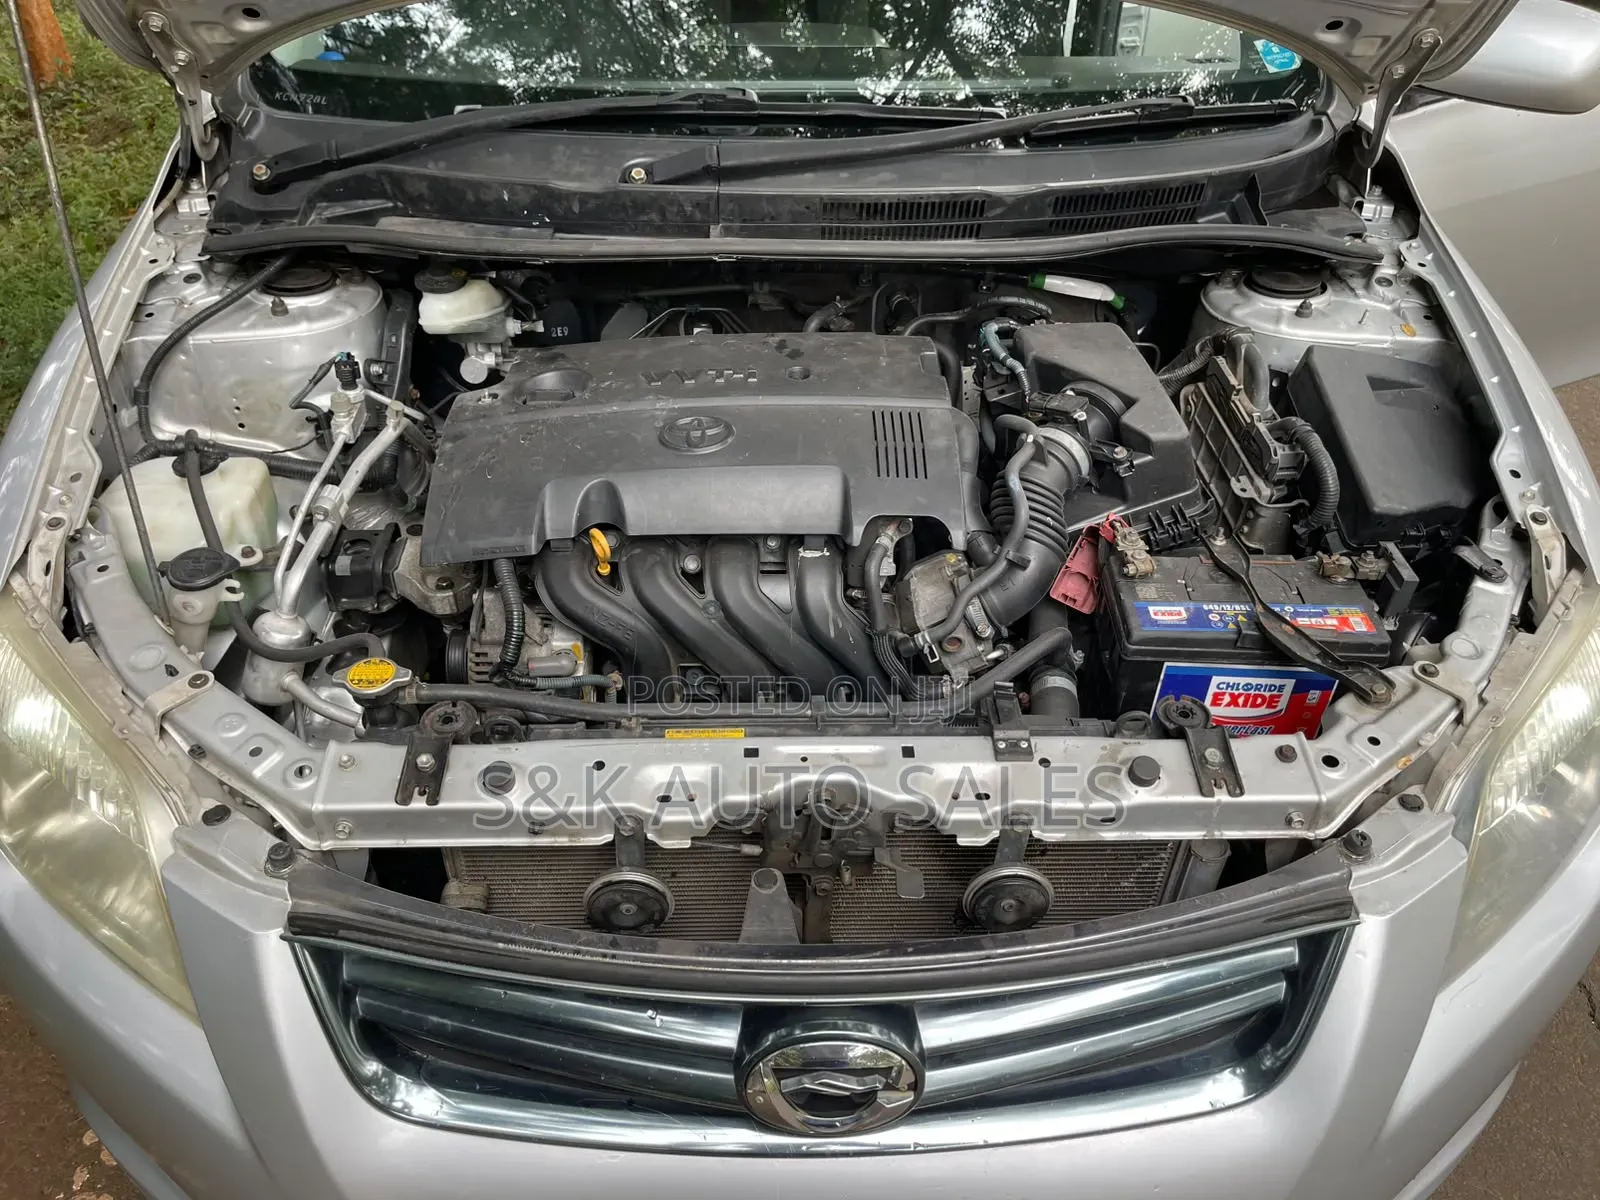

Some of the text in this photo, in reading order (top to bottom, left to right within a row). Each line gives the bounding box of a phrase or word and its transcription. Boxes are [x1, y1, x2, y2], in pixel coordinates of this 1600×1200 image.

[550, 326, 569, 337] 2E9
[1216, 681, 1287, 693] CHLORIDE
[1209, 691, 1284, 709] EXIDE
